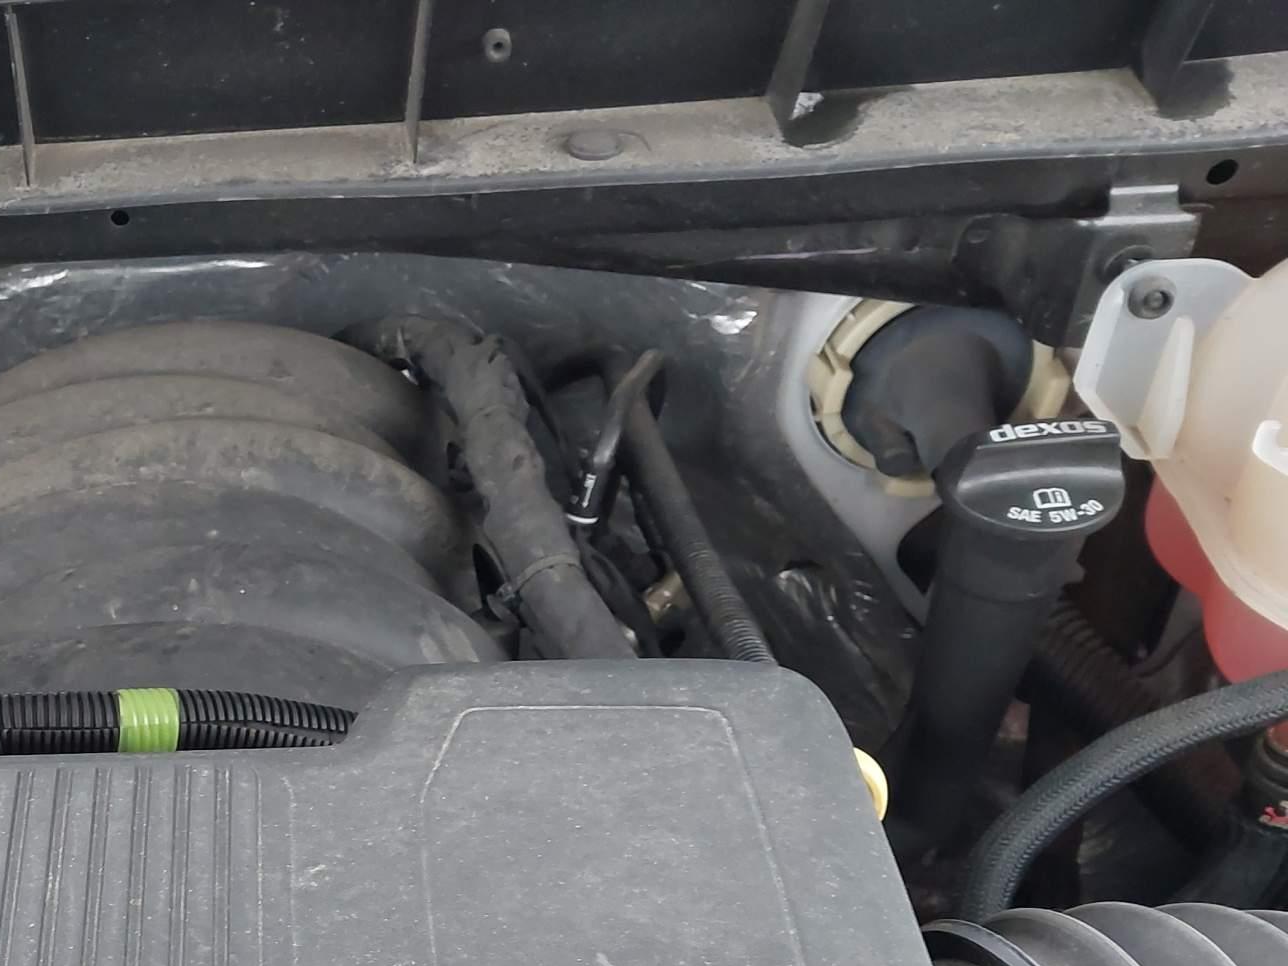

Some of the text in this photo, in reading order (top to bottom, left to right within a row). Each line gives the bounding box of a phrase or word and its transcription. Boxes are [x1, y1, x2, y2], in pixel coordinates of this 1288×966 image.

[989, 420, 1107, 442] dexos
[1006, 499, 1104, 524] SAE 5W-30
